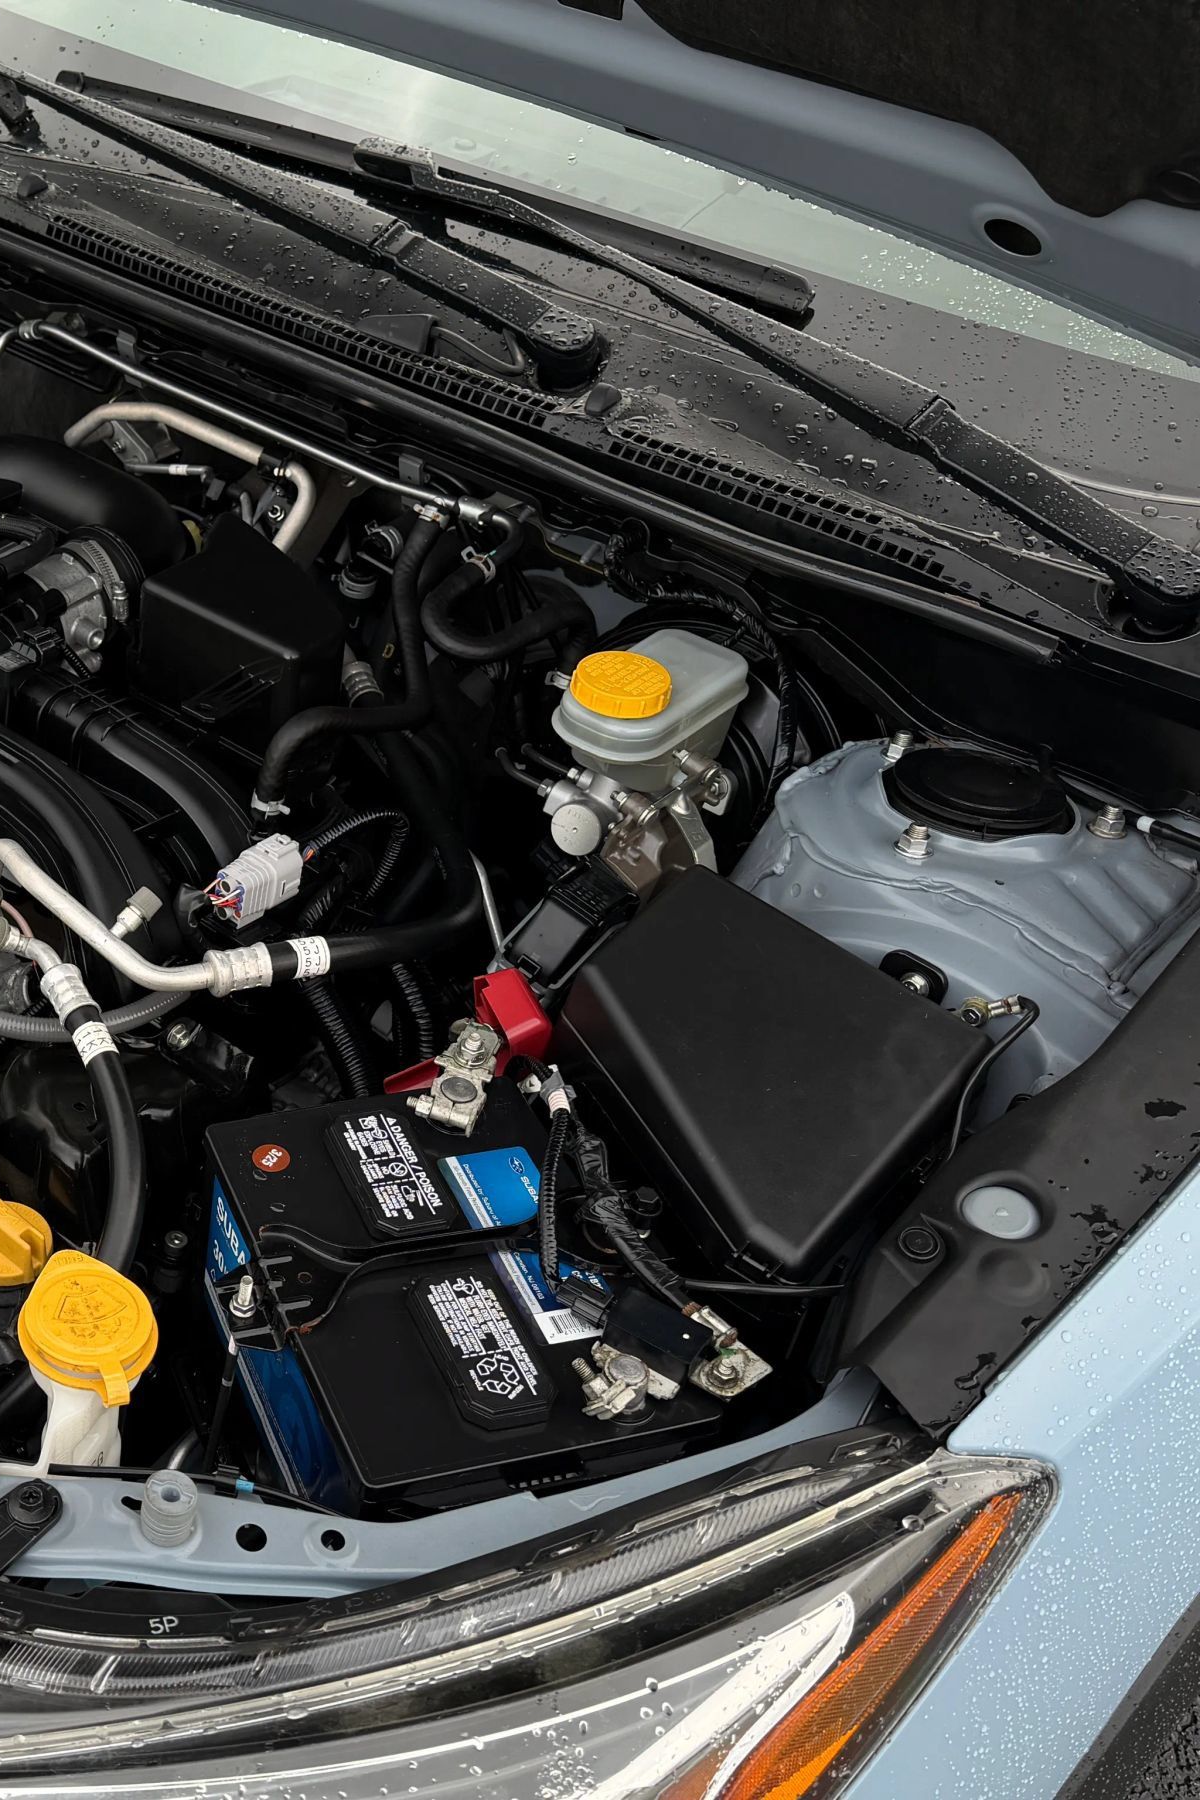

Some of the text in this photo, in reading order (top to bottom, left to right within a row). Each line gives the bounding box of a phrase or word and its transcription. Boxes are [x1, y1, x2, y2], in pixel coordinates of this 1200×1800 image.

[261, 1148, 283, 1168] 3/25
[390, 1125, 419, 1163] DANGER
[415, 1171, 443, 1207] POISON
[520, 1175, 542, 1204] SUBA
[149, 1616, 179, 1635] 5P
